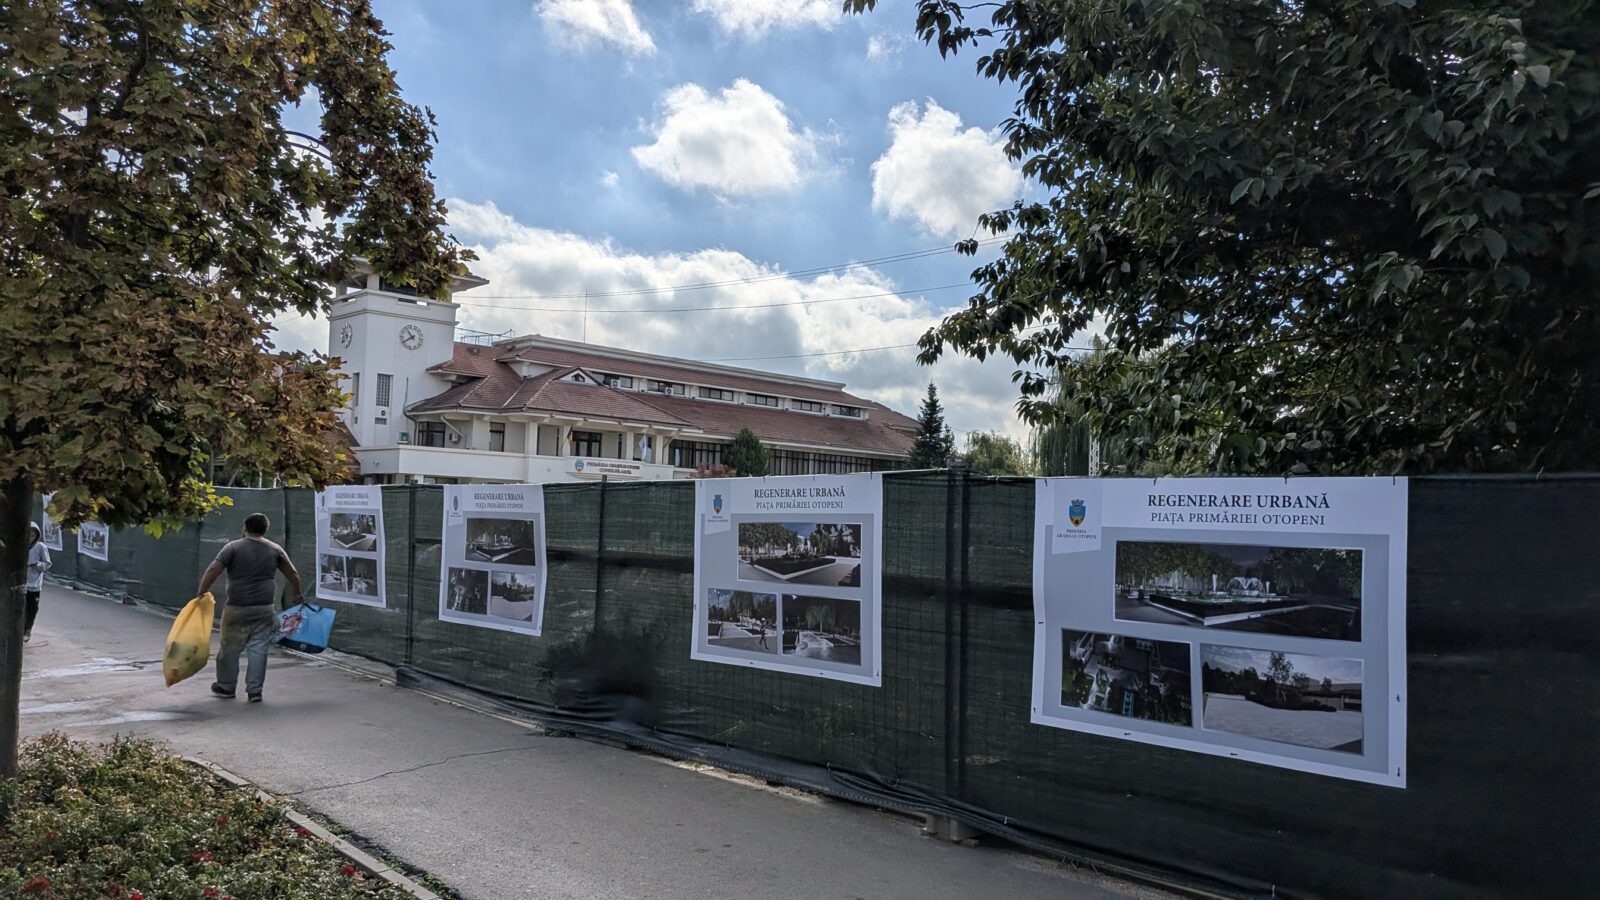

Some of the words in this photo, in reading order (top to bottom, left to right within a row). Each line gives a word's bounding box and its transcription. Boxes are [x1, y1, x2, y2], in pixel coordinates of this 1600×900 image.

[754, 488, 807, 498] REGENERARE
[809, 486, 845, 497] URBANĂ
[775, 500, 811, 509] PRIMĂRIEI
[811, 501, 843, 509] OTOPENI
[1147, 494, 1253, 507] REGENERARE
[1257, 493, 1330, 509] URBANĂ
[1151, 512, 1184, 524] PIAȚA
[1189, 511, 1258, 524] PRIMĂRIEI
[1262, 514, 1325, 525] OTOPENI
